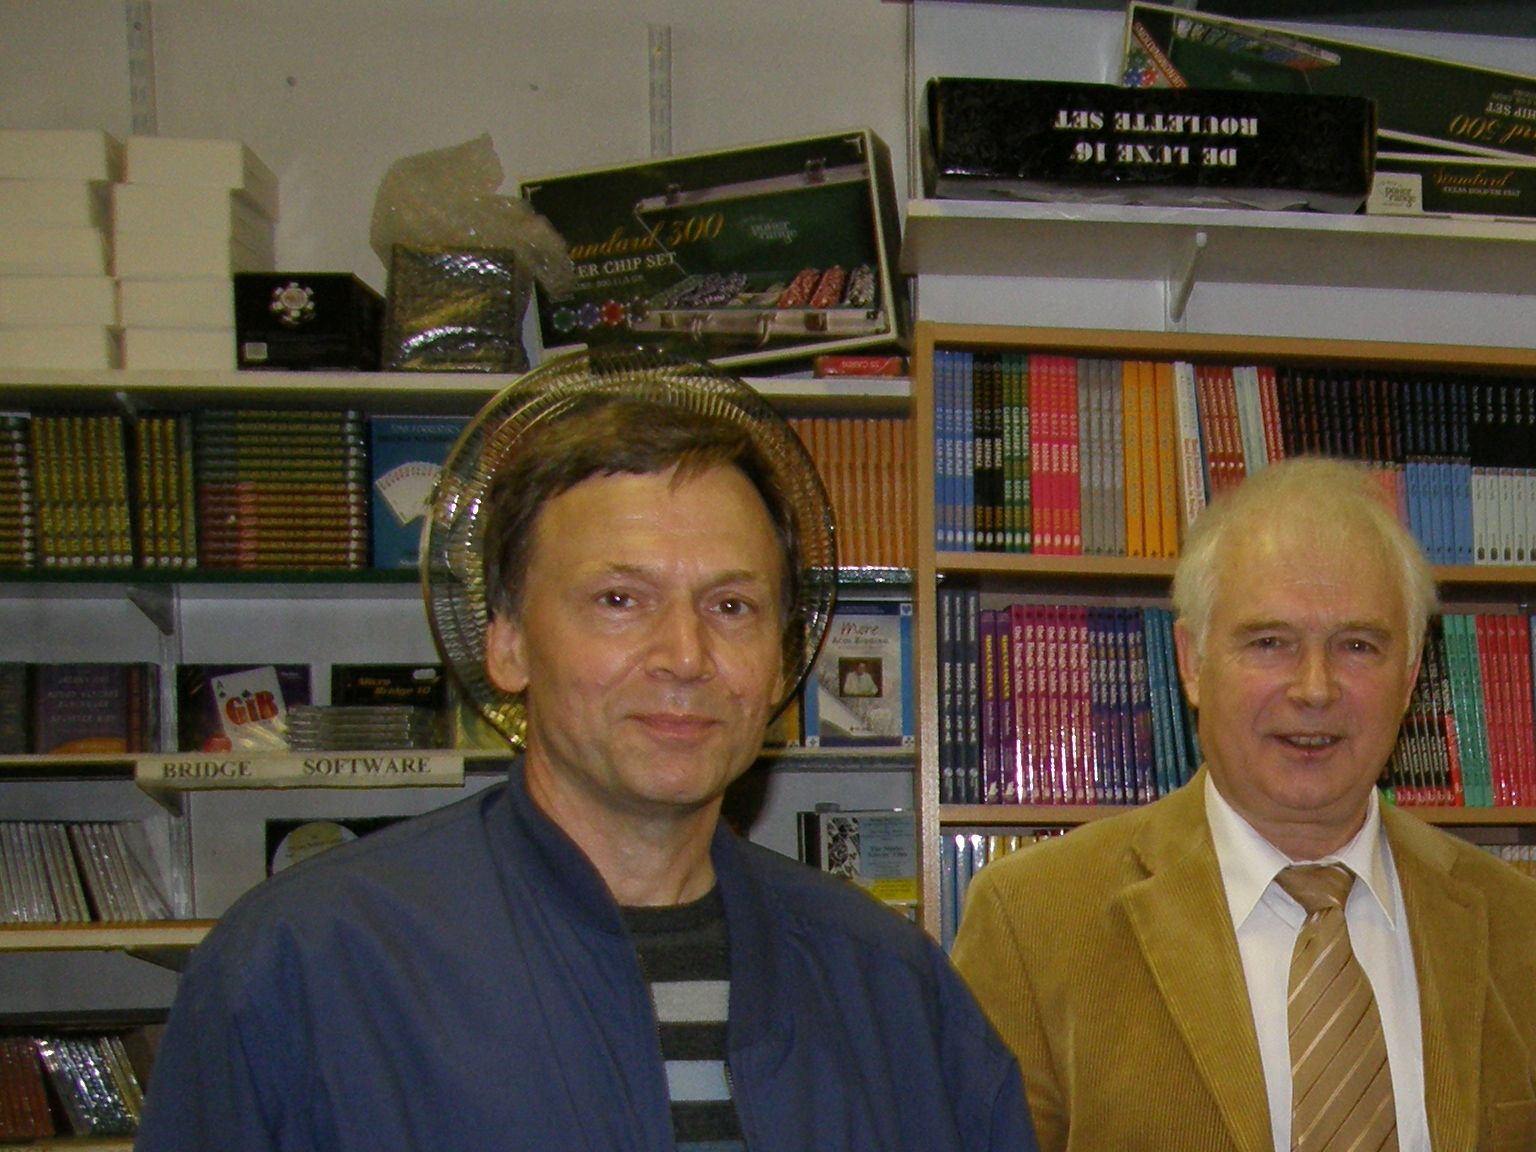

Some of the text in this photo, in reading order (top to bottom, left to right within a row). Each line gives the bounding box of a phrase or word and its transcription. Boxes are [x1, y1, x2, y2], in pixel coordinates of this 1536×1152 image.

[1485, 101, 1512, 116] SET
[1054, 110, 1259, 136] ROULETTE SET
[1117, 143, 1190, 164] LUXE
[1202, 147, 1237, 166] DE
[567, 220, 664, 257] andard
[602, 257, 642, 275] CHIP
[648, 251, 677, 268] SET
[163, 757, 432, 778] BRIDGE SOFTWARE
